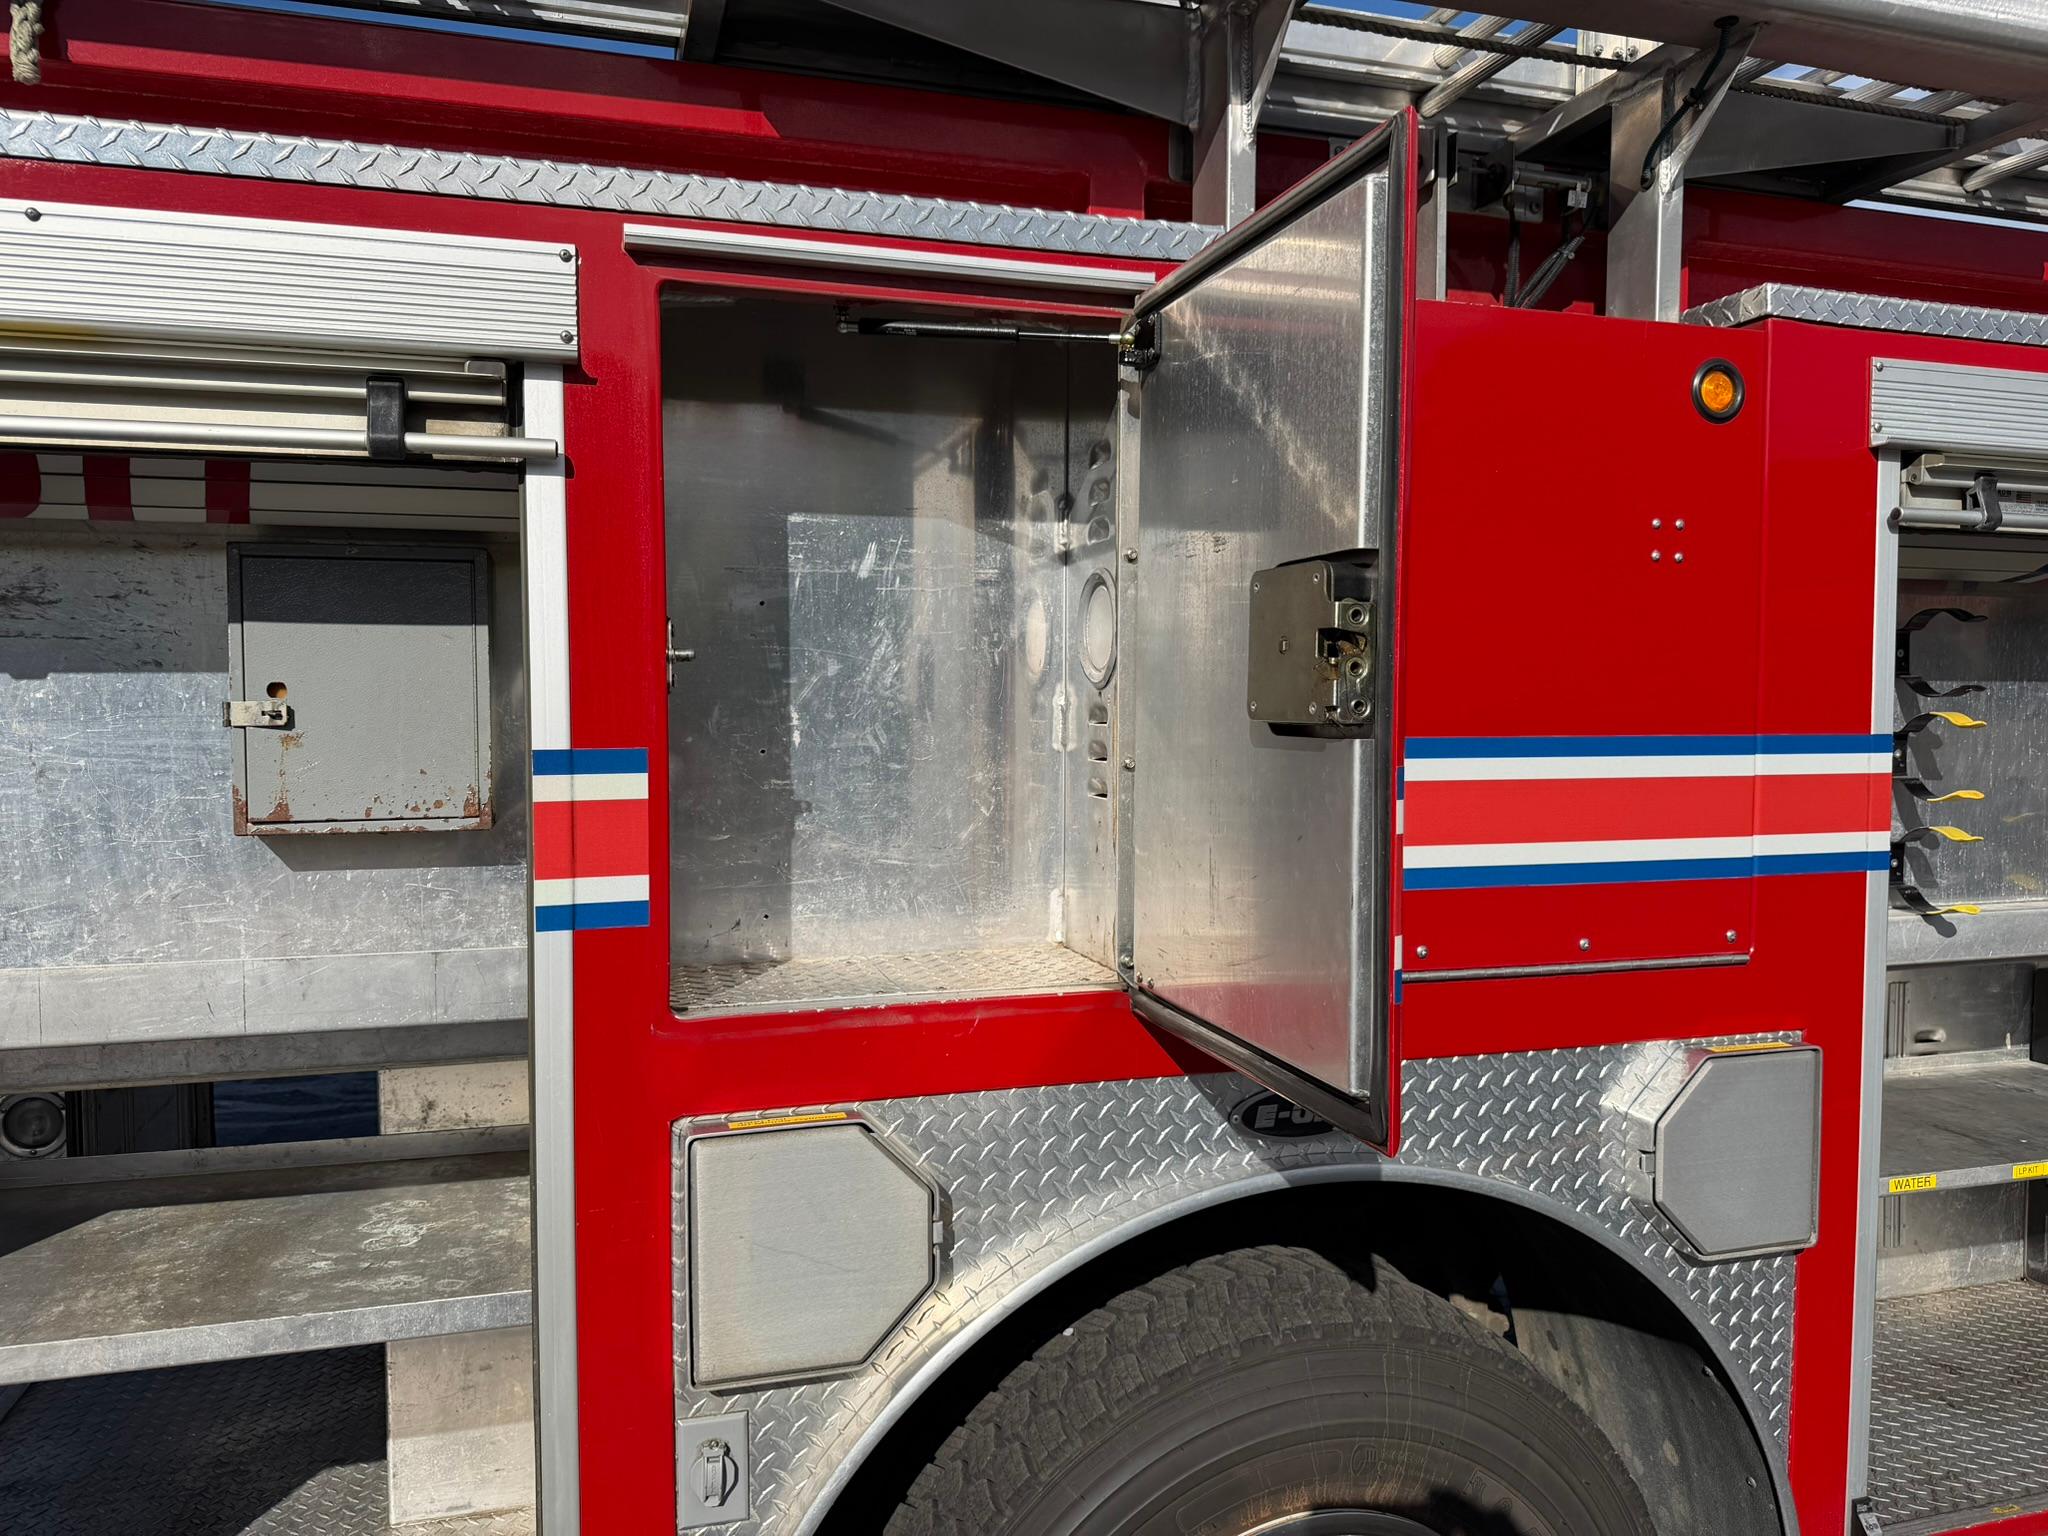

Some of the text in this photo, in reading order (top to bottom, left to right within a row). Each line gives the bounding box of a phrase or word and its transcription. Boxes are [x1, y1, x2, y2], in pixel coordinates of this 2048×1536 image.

[1254, 1103, 1323, 1128] E-O
[2018, 1165, 2039, 1175] LP KIT
[1894, 1176, 1931, 1191] WATER
